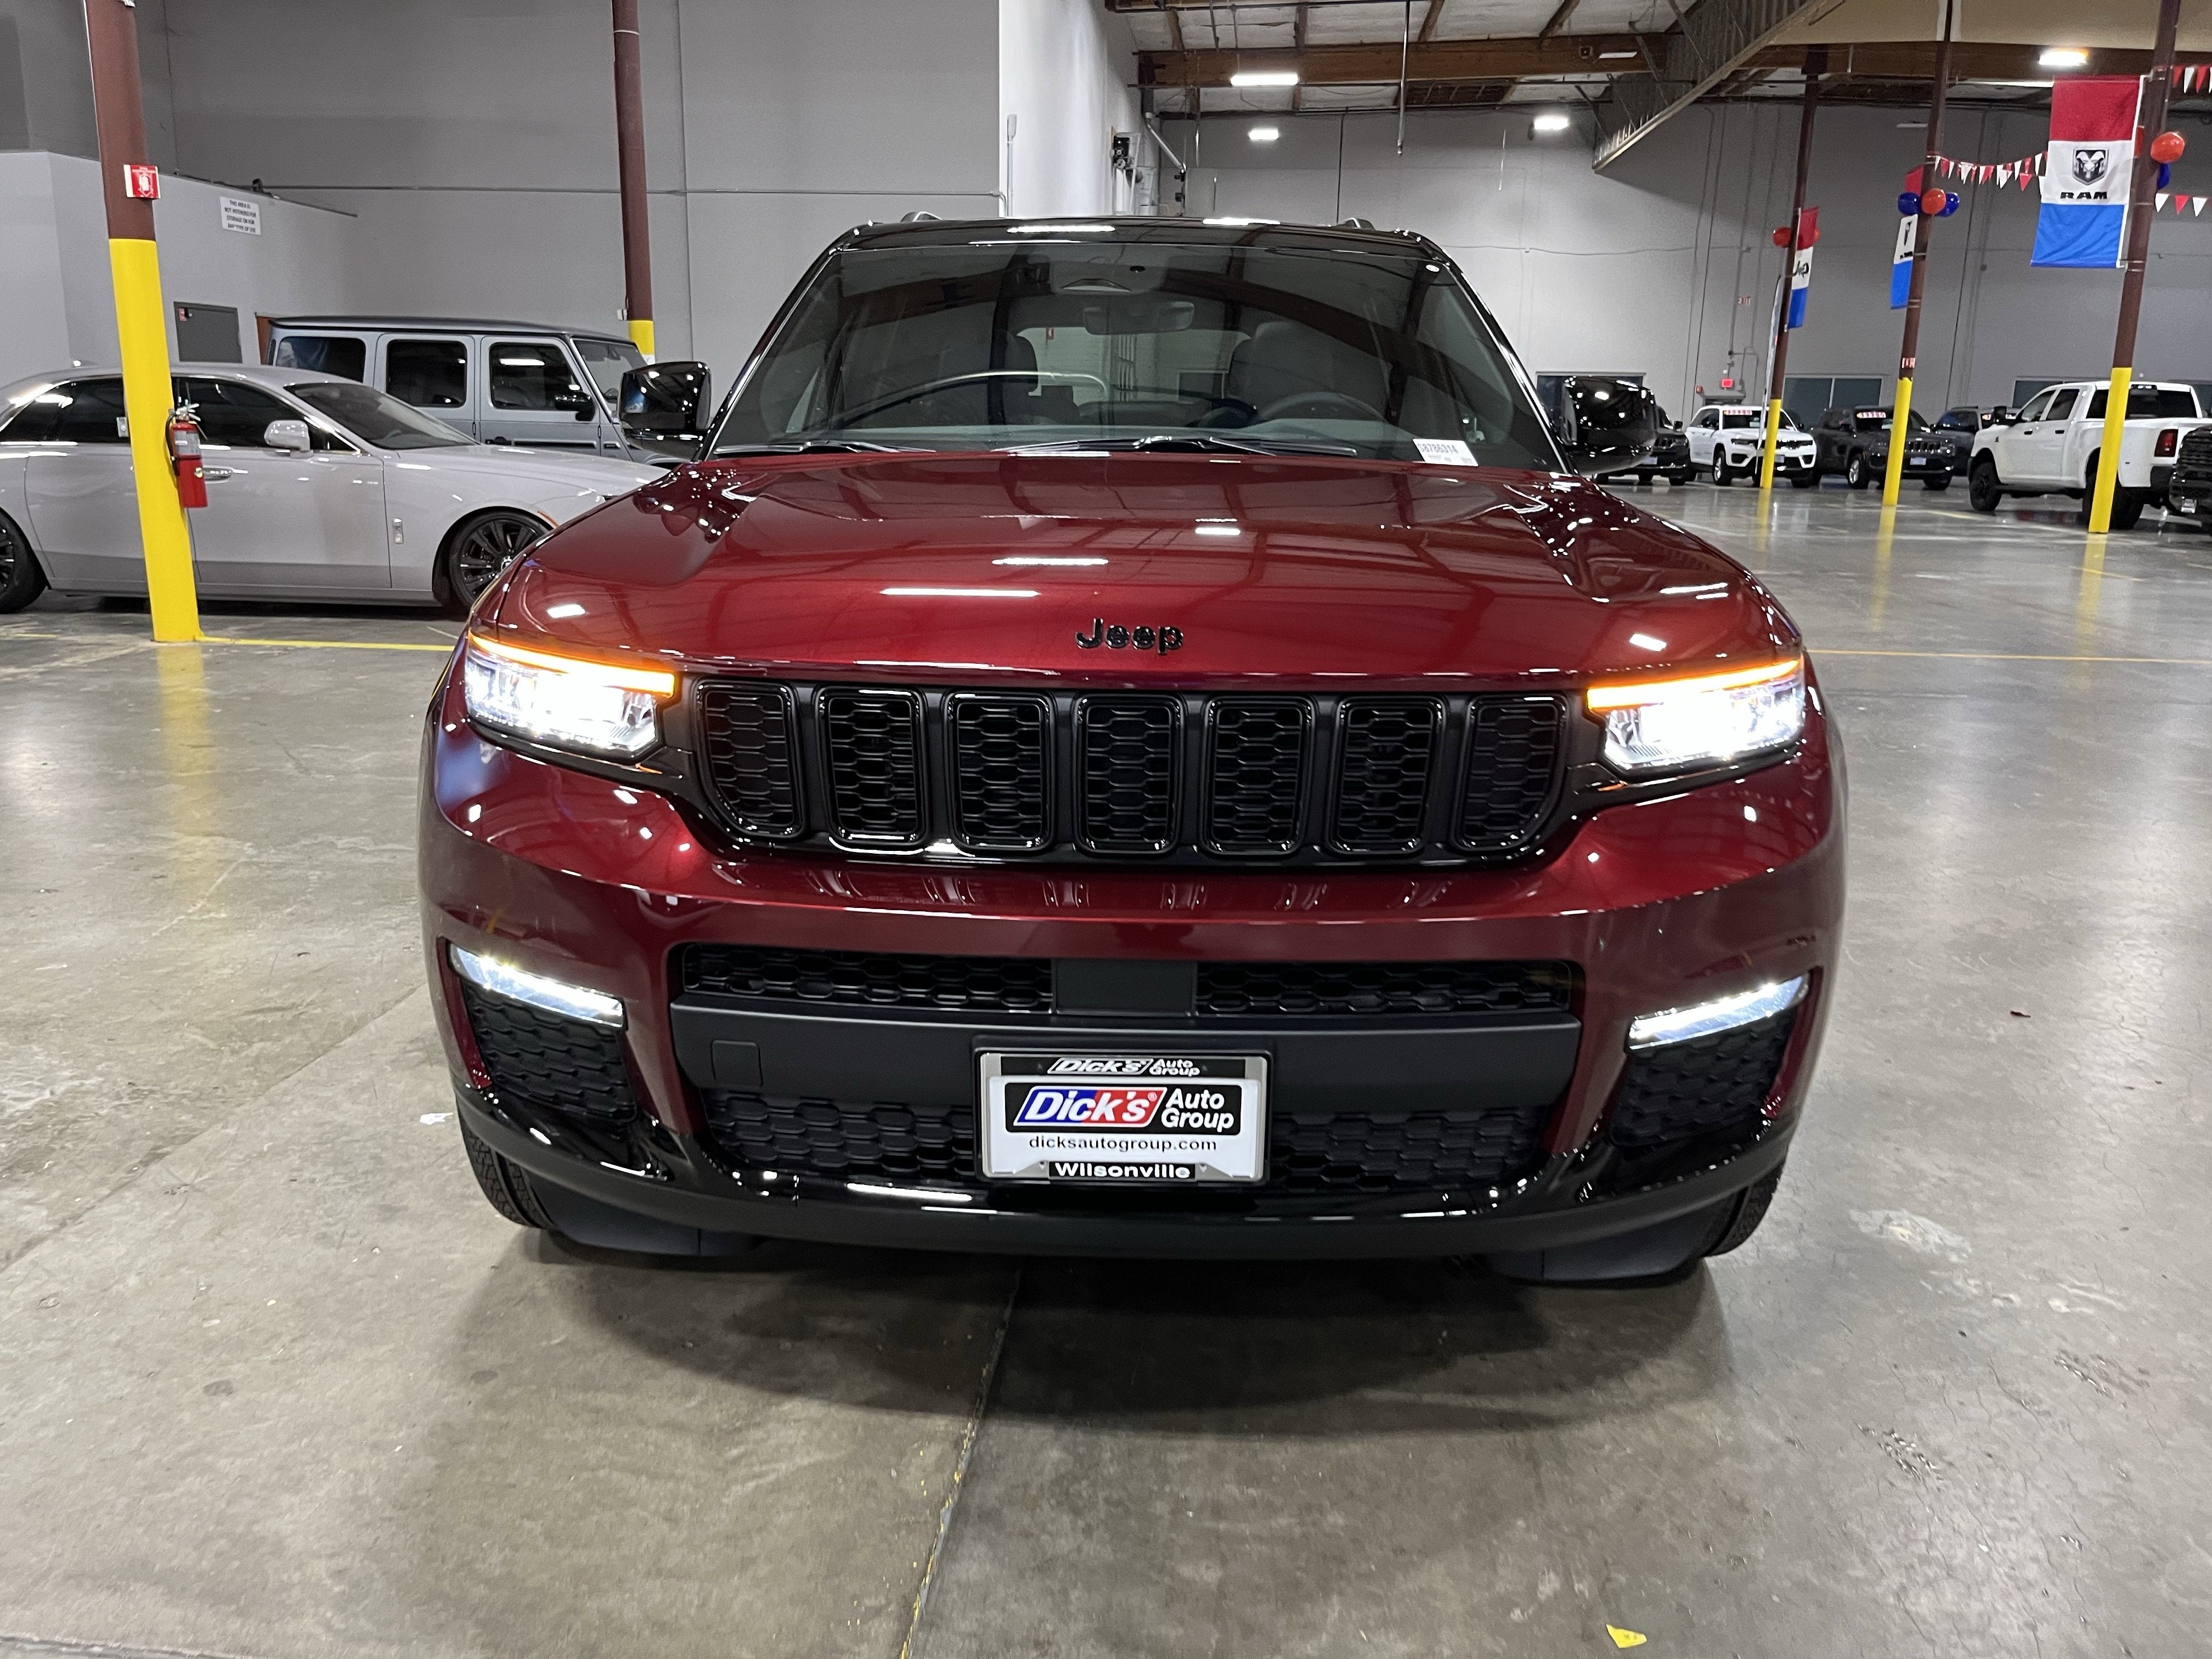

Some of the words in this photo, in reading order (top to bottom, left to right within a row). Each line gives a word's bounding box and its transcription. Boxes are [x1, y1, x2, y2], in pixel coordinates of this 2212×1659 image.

[1075, 618, 1184, 656] Jeep
[1149, 1066, 1200, 1077] Group
[1153, 1058, 1193, 1068] Auto
[1024, 1091, 1150, 1122] Dick's
[1165, 1088, 1225, 1110] Auto
[1161, 1107, 1234, 1133] Group
[1029, 1136, 1217, 1153] dicksautogroup.com
[1054, 1162, 1191, 1179] Wilsonville
